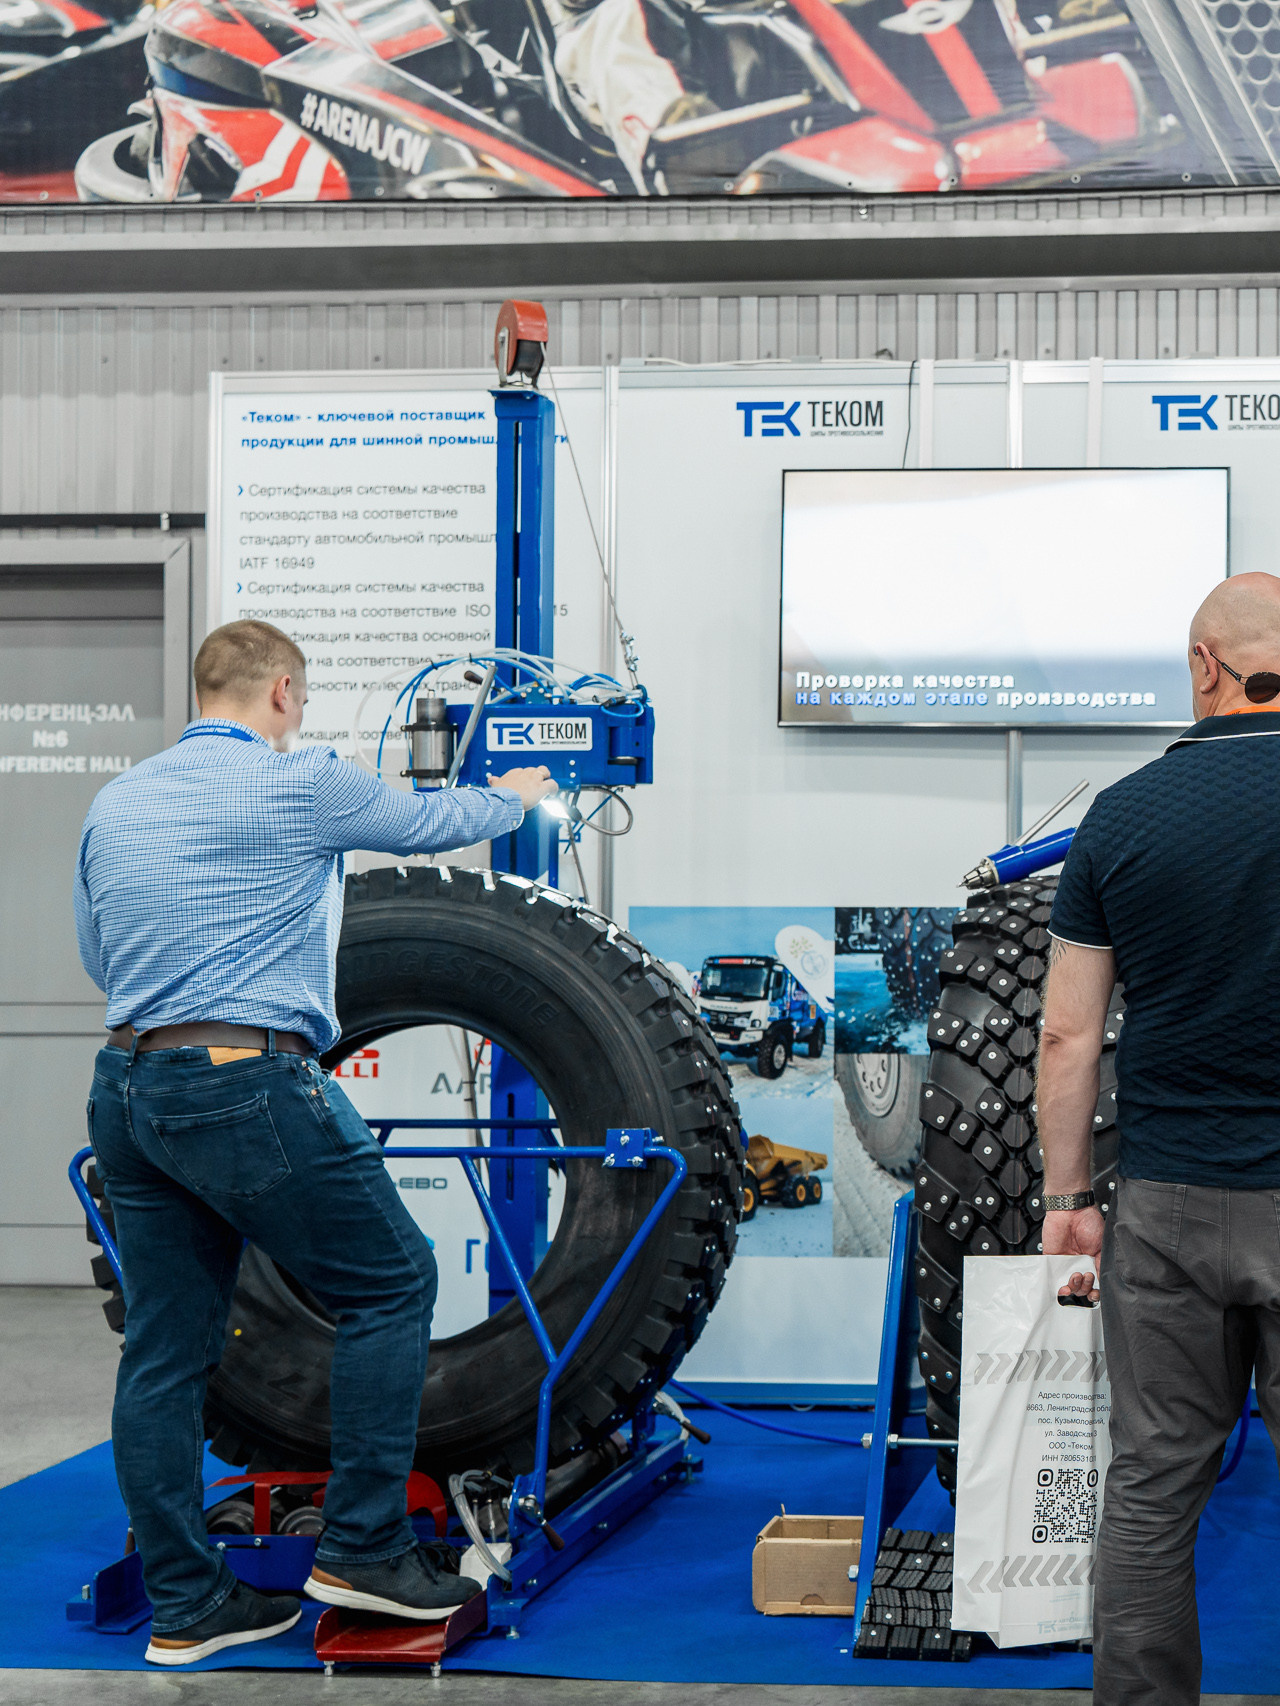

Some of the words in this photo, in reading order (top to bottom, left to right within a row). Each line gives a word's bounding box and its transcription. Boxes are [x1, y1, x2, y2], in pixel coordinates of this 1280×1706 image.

[300, 92, 431, 175] #ARENAJCW
[317, 412, 395, 422] ключевой
[400, 411, 486, 422] поставщик
[807, 400, 884, 427] ТЕКОМ
[241, 437, 324, 450] продукции
[329, 437, 357, 448] для
[362, 436, 423, 446] шинной
[248, 483, 353, 499] Сертификация
[356, 484, 419, 496] системы
[421, 483, 487, 495] качества
[239, 509, 339, 523] производства
[341, 509, 359, 521] на
[362, 508, 459, 520] соответствие
[239, 534, 311, 548] стандарту
[314, 531, 425, 545] автомобильной
[239, 556, 269, 570] IATF
[275, 556, 316, 570] 16949
[247, 581, 352, 596] Сертификация
[355, 583, 417, 594] системы
[420, 582, 485, 593] качества
[237, 607, 337, 623] производства
[340, 607, 358, 619] на
[360, 607, 458, 618] соответствие
[465, 603, 492, 618] ISO
[291, 630, 351, 643] фикация
[354, 631, 419, 643] качества
[421, 628, 492, 643] основной
[316, 657, 334, 668] на
[795, 671, 905, 691] Проверка
[912, 675, 1015, 689] качества
[795, 692, 821, 706] на
[829, 692, 916, 709] каждом
[925, 692, 989, 706] этапе
[996, 691, 1157, 709] производства
[0, 703, 136, 725] НФЕРЕНЦ-ЗАЛ
[32, 729, 69, 749] №6
[538, 722, 587, 740] ТЕКОМ
[0, 755, 87, 773] NFERENCE
[89, 755, 132, 773] HALL
[1037, 1391, 1061, 1400] Адрес
[1048, 1441, 1066, 1450] ООО
[1041, 1454, 1059, 1462] ИНН
